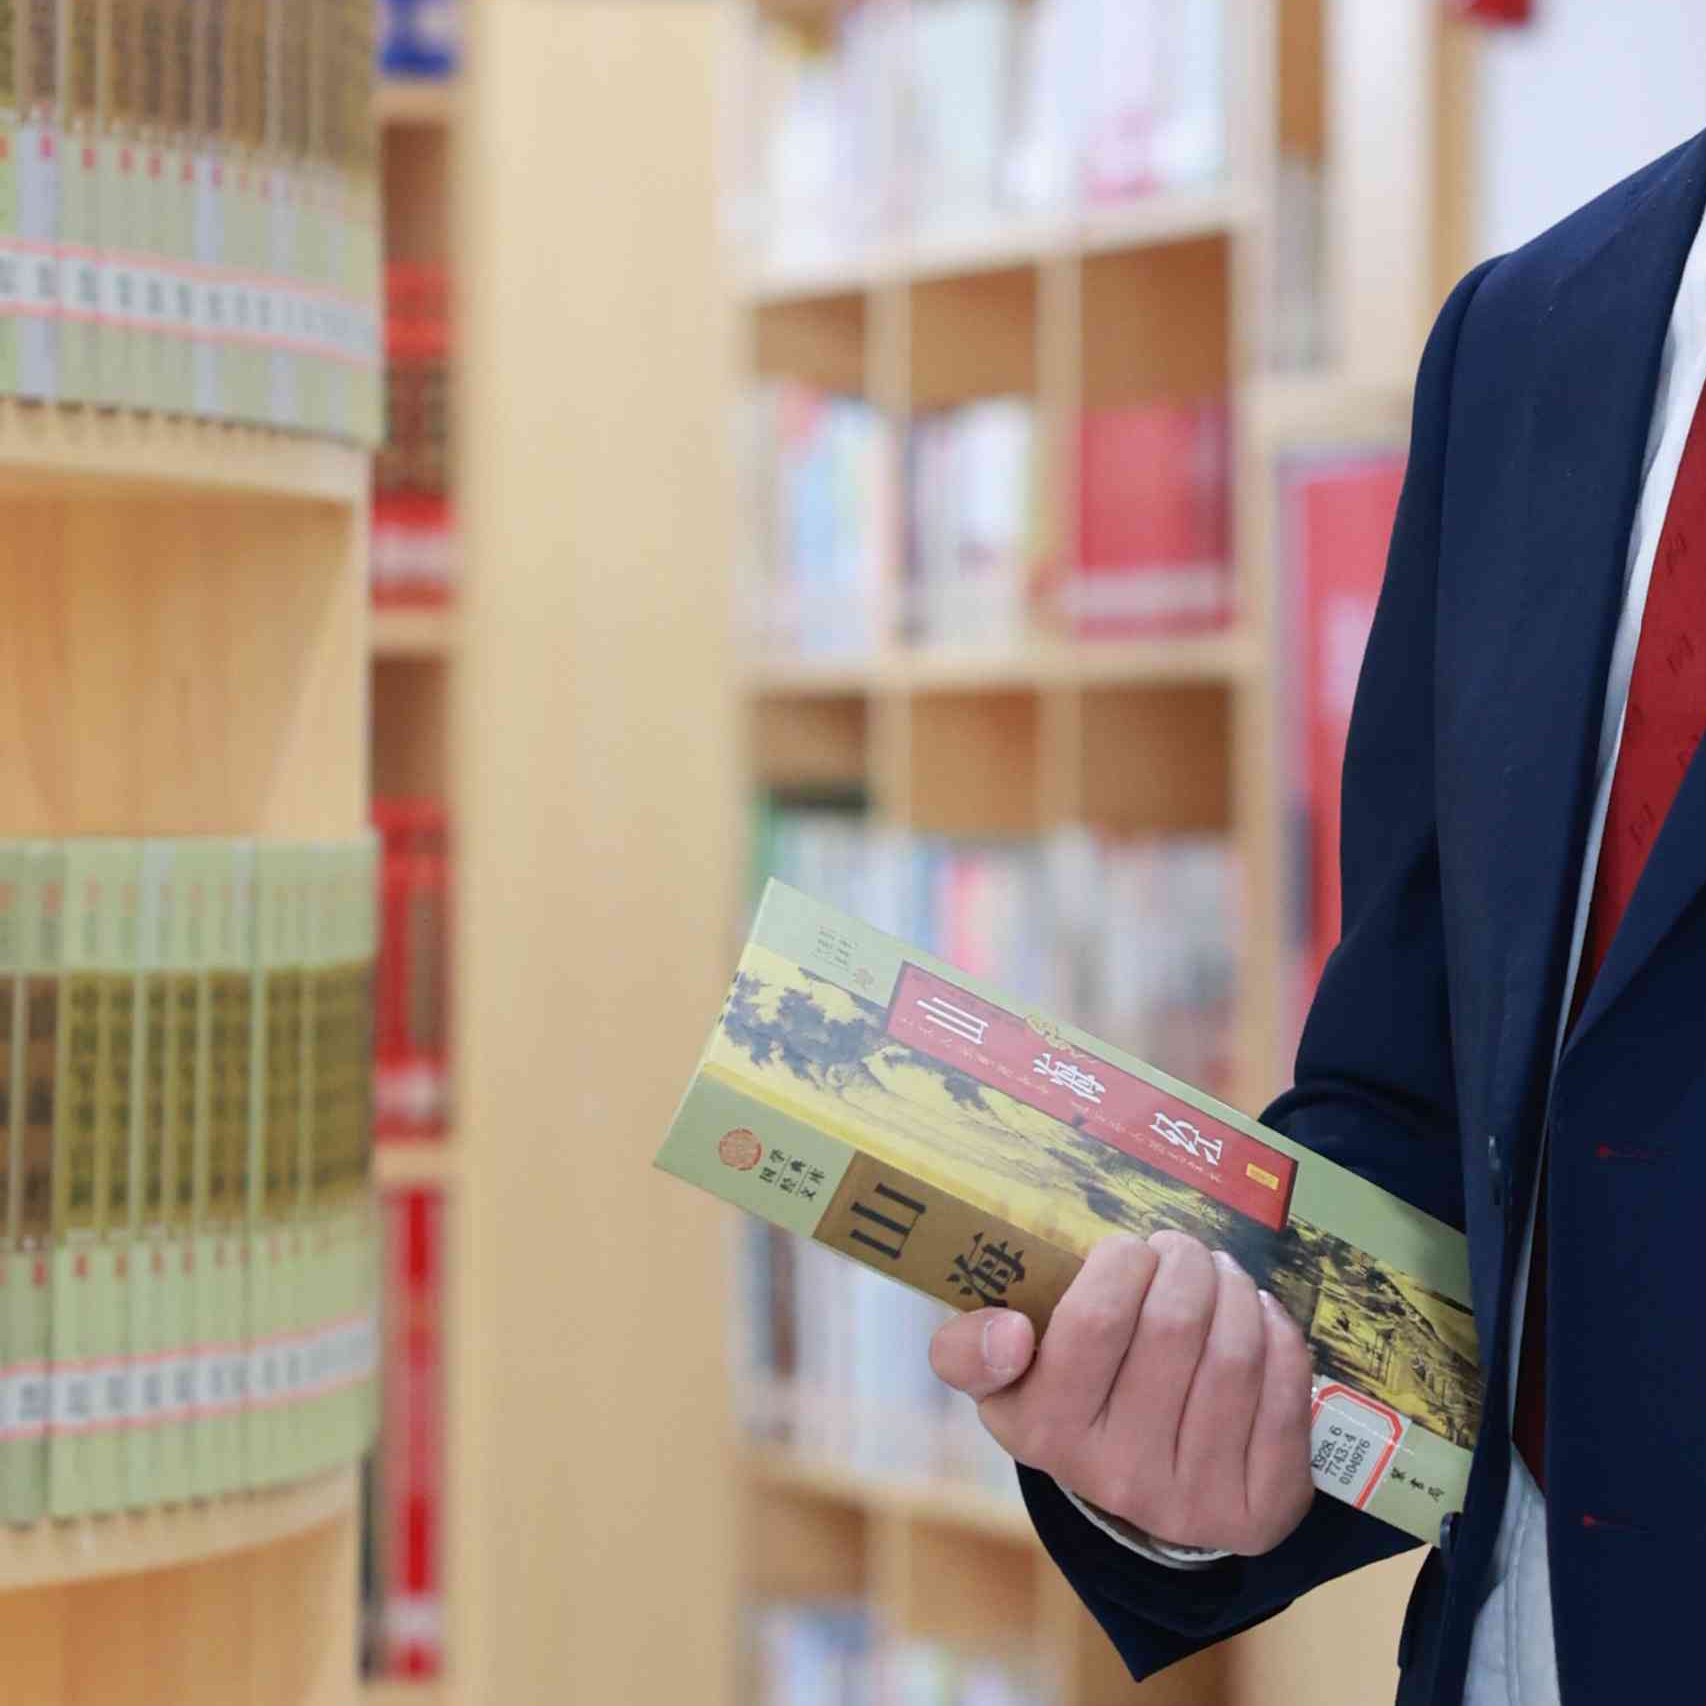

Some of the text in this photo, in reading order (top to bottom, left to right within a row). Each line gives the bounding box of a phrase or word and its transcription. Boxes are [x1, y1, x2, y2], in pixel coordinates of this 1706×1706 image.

[915, 996, 1224, 1166] 山海经
[759, 1148, 786, 1184] 国学
[780, 1159, 807, 1195] 经典
[849, 1182, 1026, 1308] 山海
[1325, 1432, 1357, 1477] 7743:4
[1339, 1438, 1371, 1486] 0104976
